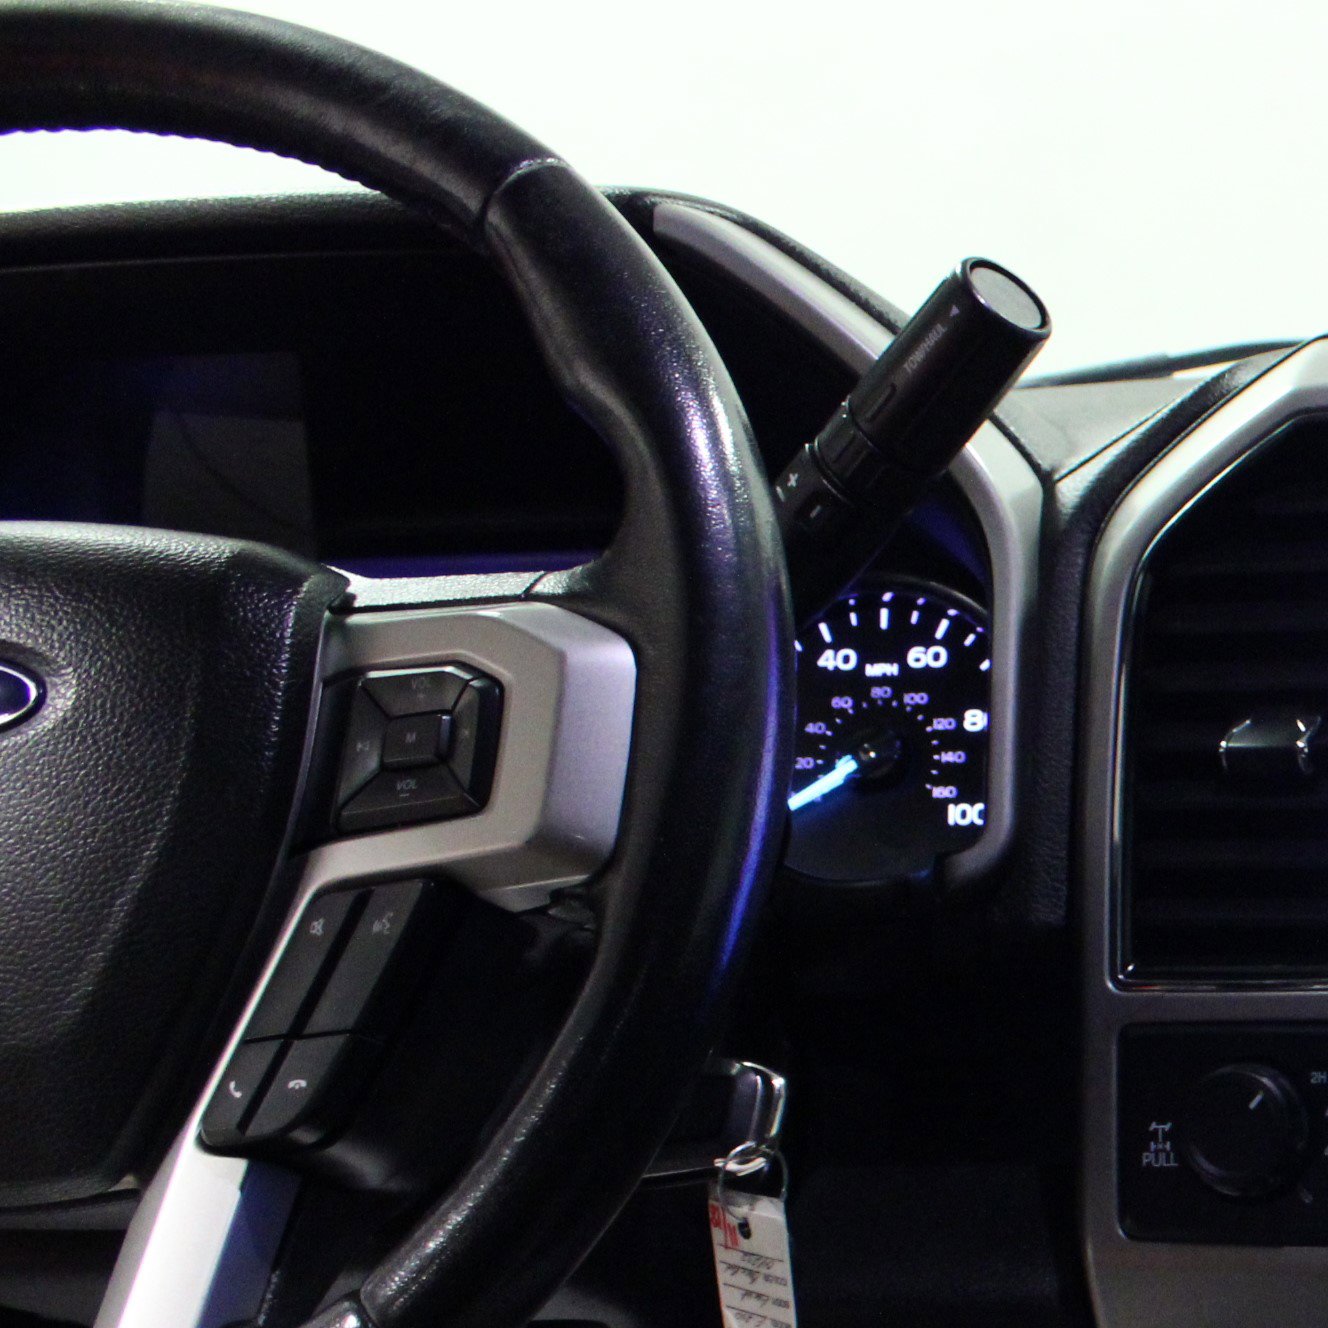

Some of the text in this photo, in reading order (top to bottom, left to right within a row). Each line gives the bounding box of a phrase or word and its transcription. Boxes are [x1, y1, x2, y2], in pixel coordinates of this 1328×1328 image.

[817, 648, 858, 671] 40
[906, 646, 948, 669] 60
[864, 663, 899, 677] MPH
[870, 686, 893, 698] 80
[903, 692, 929, 705] 100
[831, 696, 853, 709] 60
[805, 721, 827, 734] 40
[932, 717, 956, 730] 120
[940, 751, 966, 764] 140
[397, 779, 417, 790] VOL
[931, 785, 958, 799] 160
[1310, 1071, 1328, 1085] 2H
[1142, 1152, 1178, 1167] PULL
